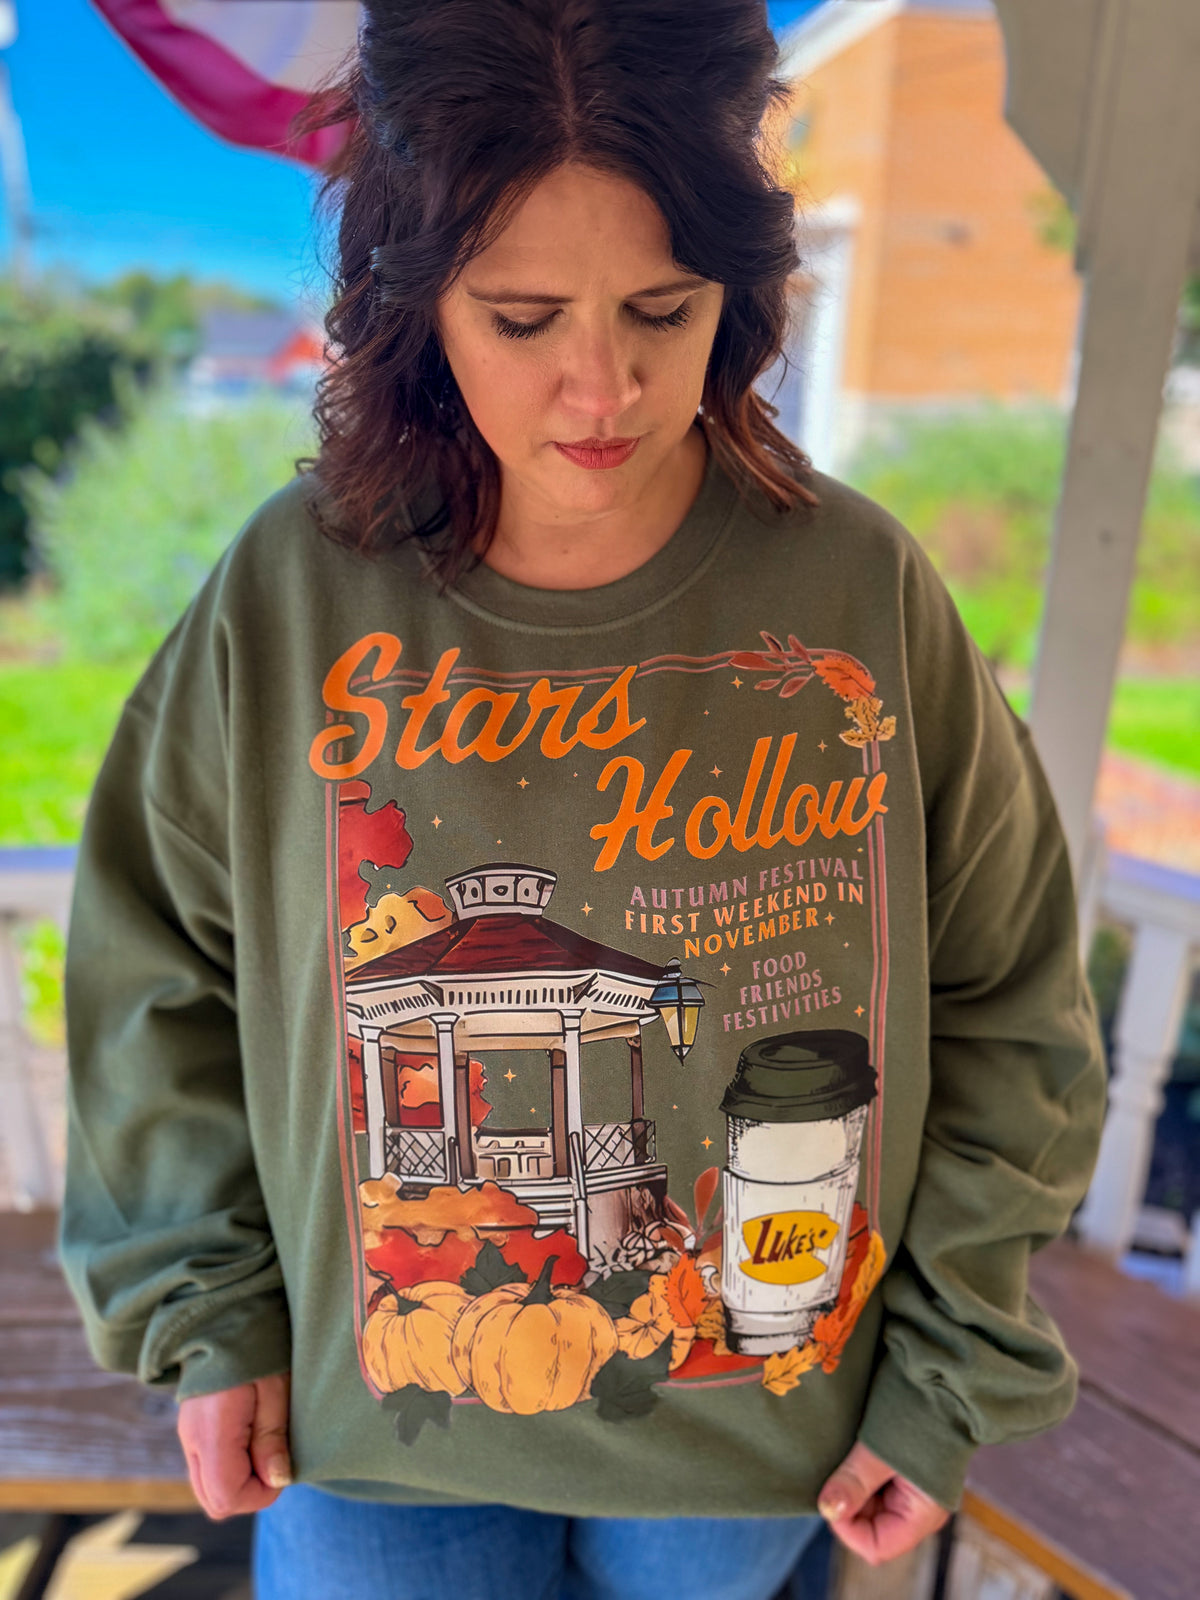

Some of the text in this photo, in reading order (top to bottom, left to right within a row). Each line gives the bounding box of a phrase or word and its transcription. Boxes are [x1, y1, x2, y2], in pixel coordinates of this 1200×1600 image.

[309, 631, 646, 780] Stars
[590, 732, 888, 872] Hollow
[625, 882, 863, 935] FIRST WEEKEND IN
[630, 857, 864, 909] AUTUMN FESTIVAL
[684, 907, 819, 959] NOVEMBER
[740, 969, 822, 1005] FRIENDS
[752, 951, 807, 979] FOOD
[723, 986, 842, 1032] FESTIVITIES
